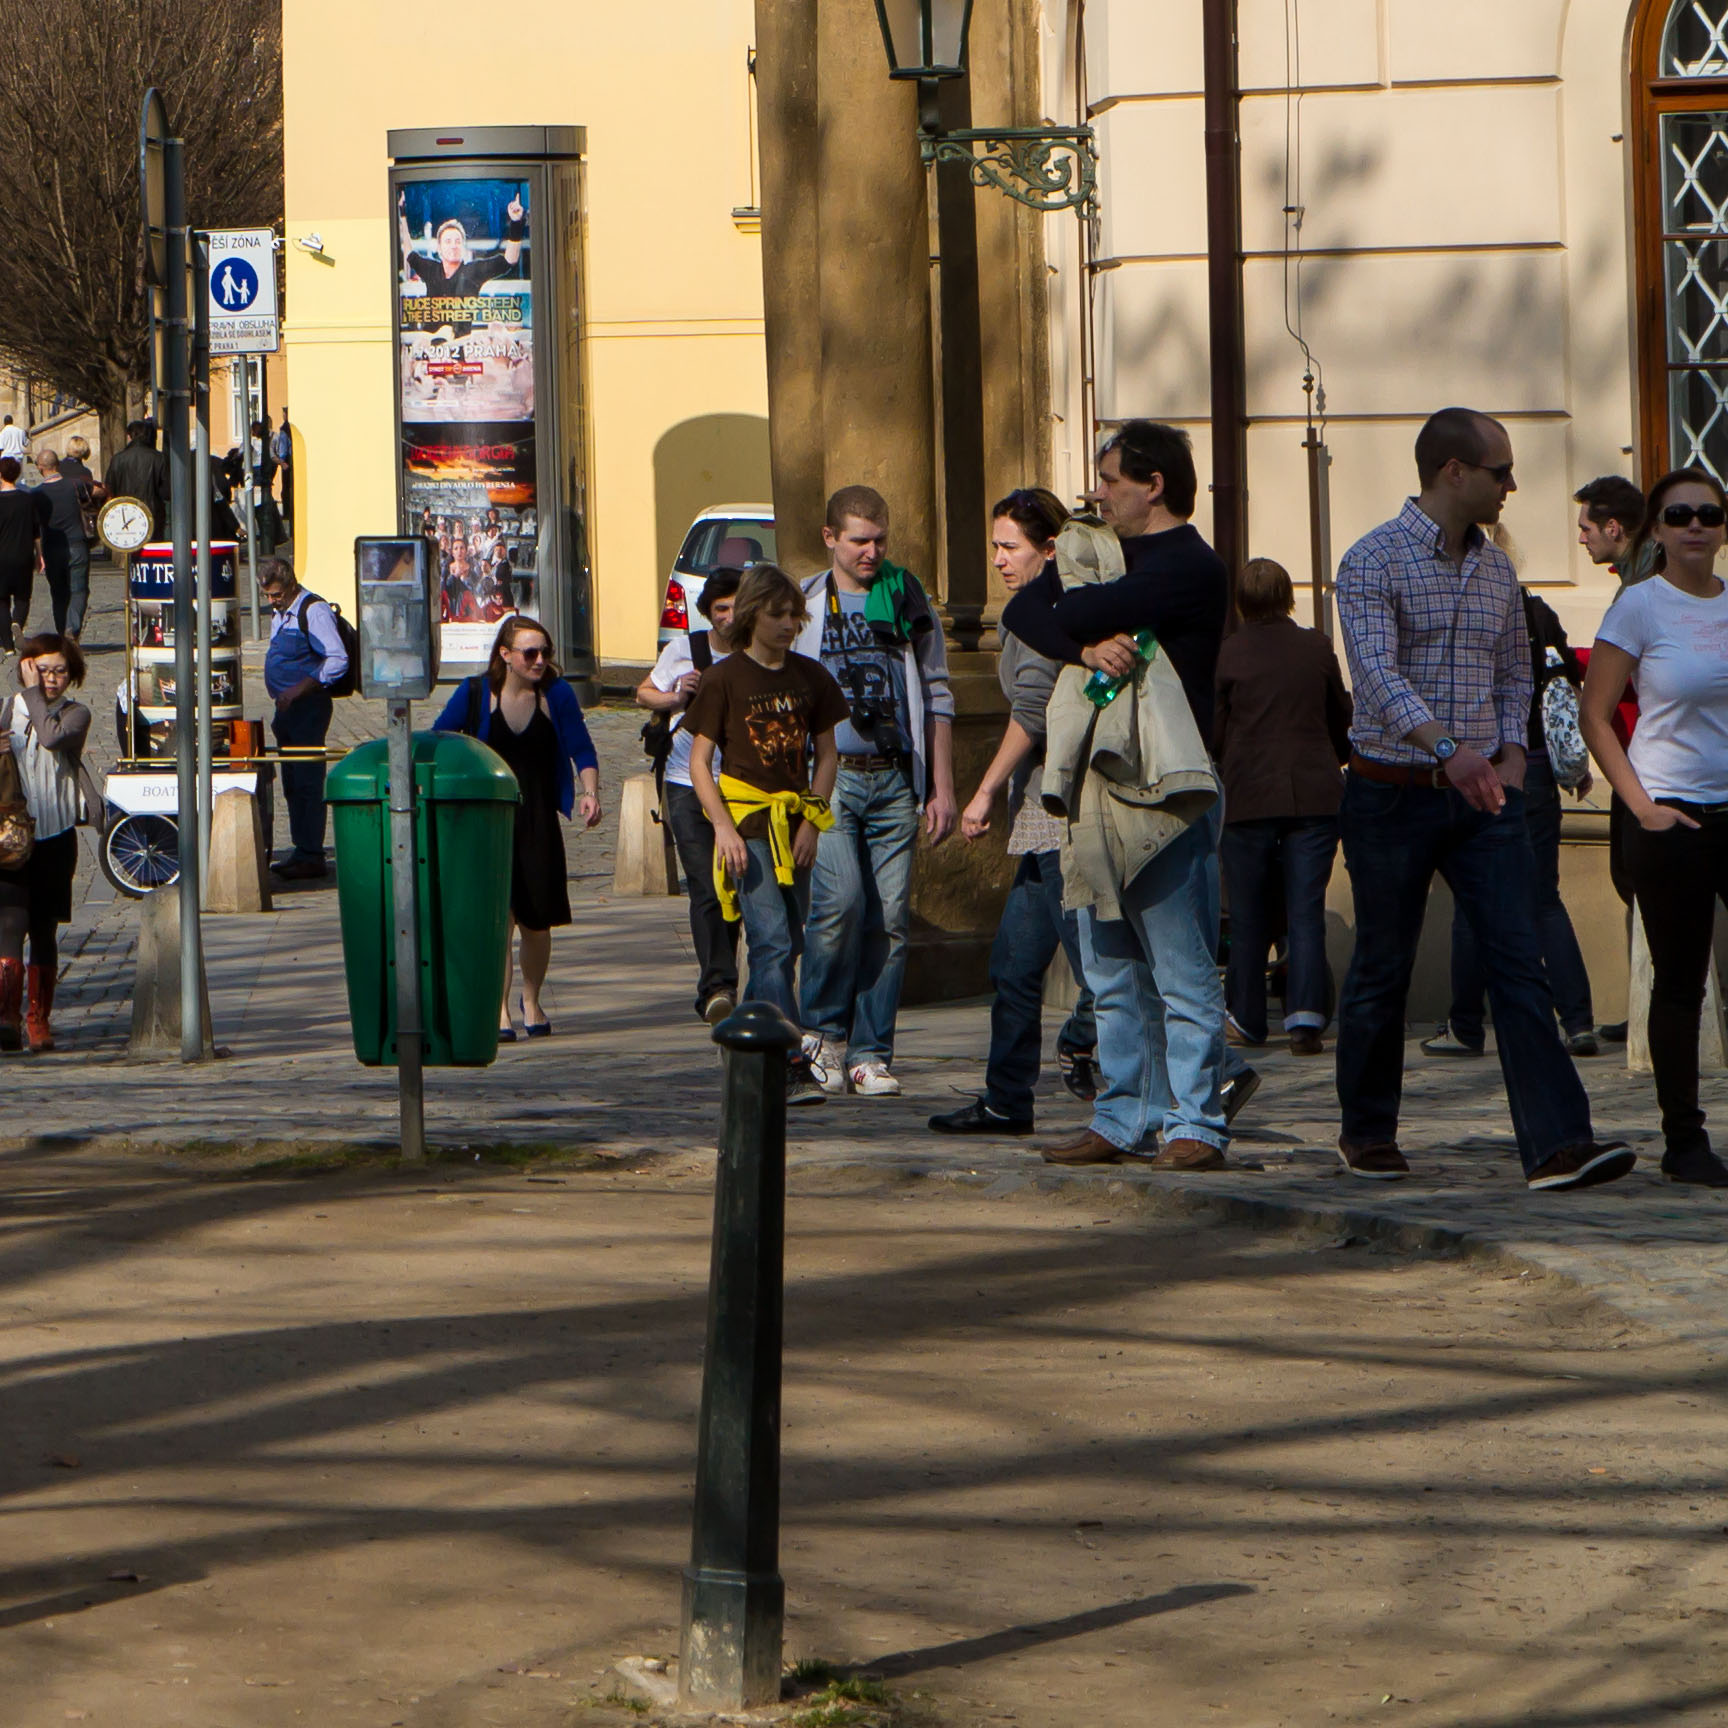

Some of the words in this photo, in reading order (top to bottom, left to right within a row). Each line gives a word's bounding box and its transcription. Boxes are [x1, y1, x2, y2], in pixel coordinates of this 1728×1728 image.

[209, 234, 228, 249] ĚŠÍ
[232, 234, 261, 249] ZÓNA
[431, 296, 520, 310] SPRINGSTEEN
[431, 309, 480, 322] STREET
[482, 308, 522, 322] BAND
[238, 318, 276, 330] OBSLUHA
[463, 343, 522, 359] PRAHA
[129, 562, 150, 584] OAT
